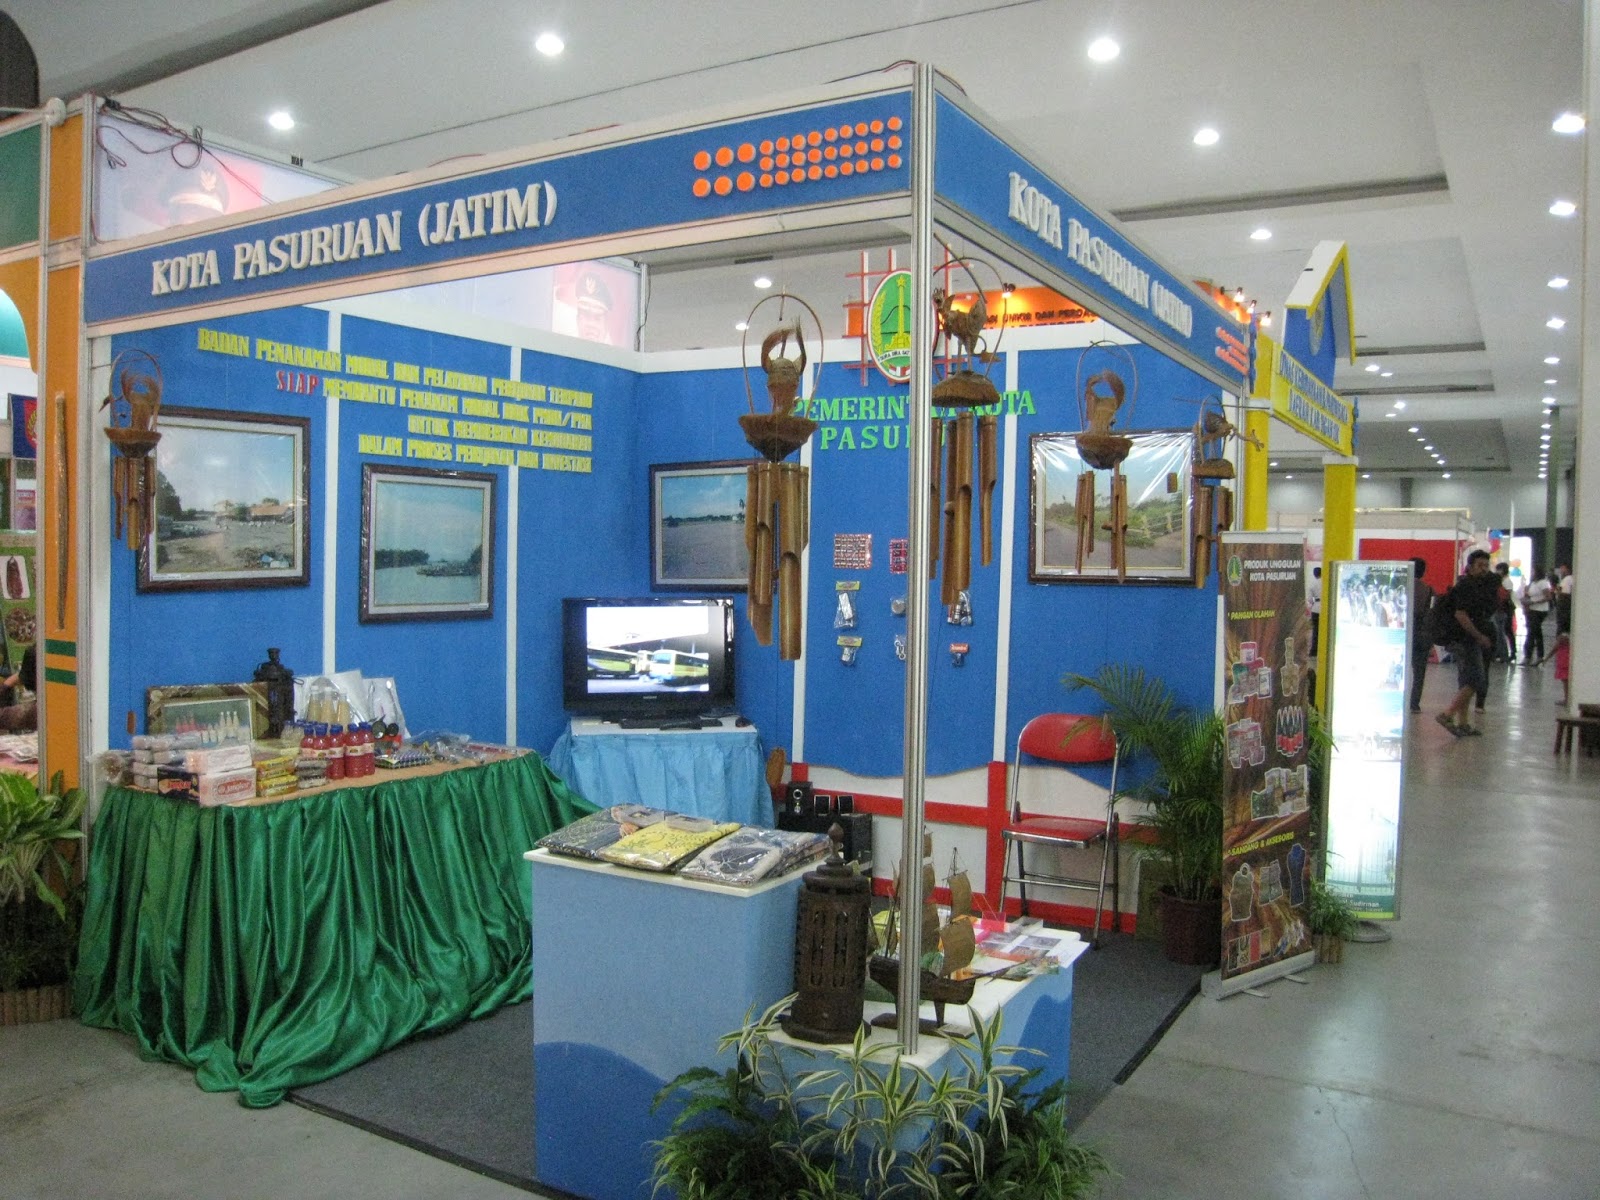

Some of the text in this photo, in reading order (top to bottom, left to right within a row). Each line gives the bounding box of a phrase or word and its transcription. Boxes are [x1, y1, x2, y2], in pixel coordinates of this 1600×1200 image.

[151, 180, 558, 296] KOTA PASURUAN (JATIM)
[1008, 172, 1063, 250] KOTA
[1068, 218, 1150, 309] PASURUAN
[198, 328, 249, 357] BADAN
[255, 338, 341, 372] PENANAMAN
[345, 354, 389, 379] MODAL
[393, 362, 420, 384] DAN
[276, 370, 319, 395] SIAP
[322, 377, 396, 405] MEMBANTU
[408, 414, 449, 437] UNTUK
[453, 420, 528, 444] MEMBERIKAN
[359, 433, 403, 456] DALAM
[406, 438, 452, 461] PROSES
[1244, 560, 1301, 570] PRODUK UNGGULAN
[1249, 572, 1296, 581] KOTA PASURUAN
[1231, 611, 1254, 620] PANGAN
[1231, 841, 1259, 856] SANDANG
